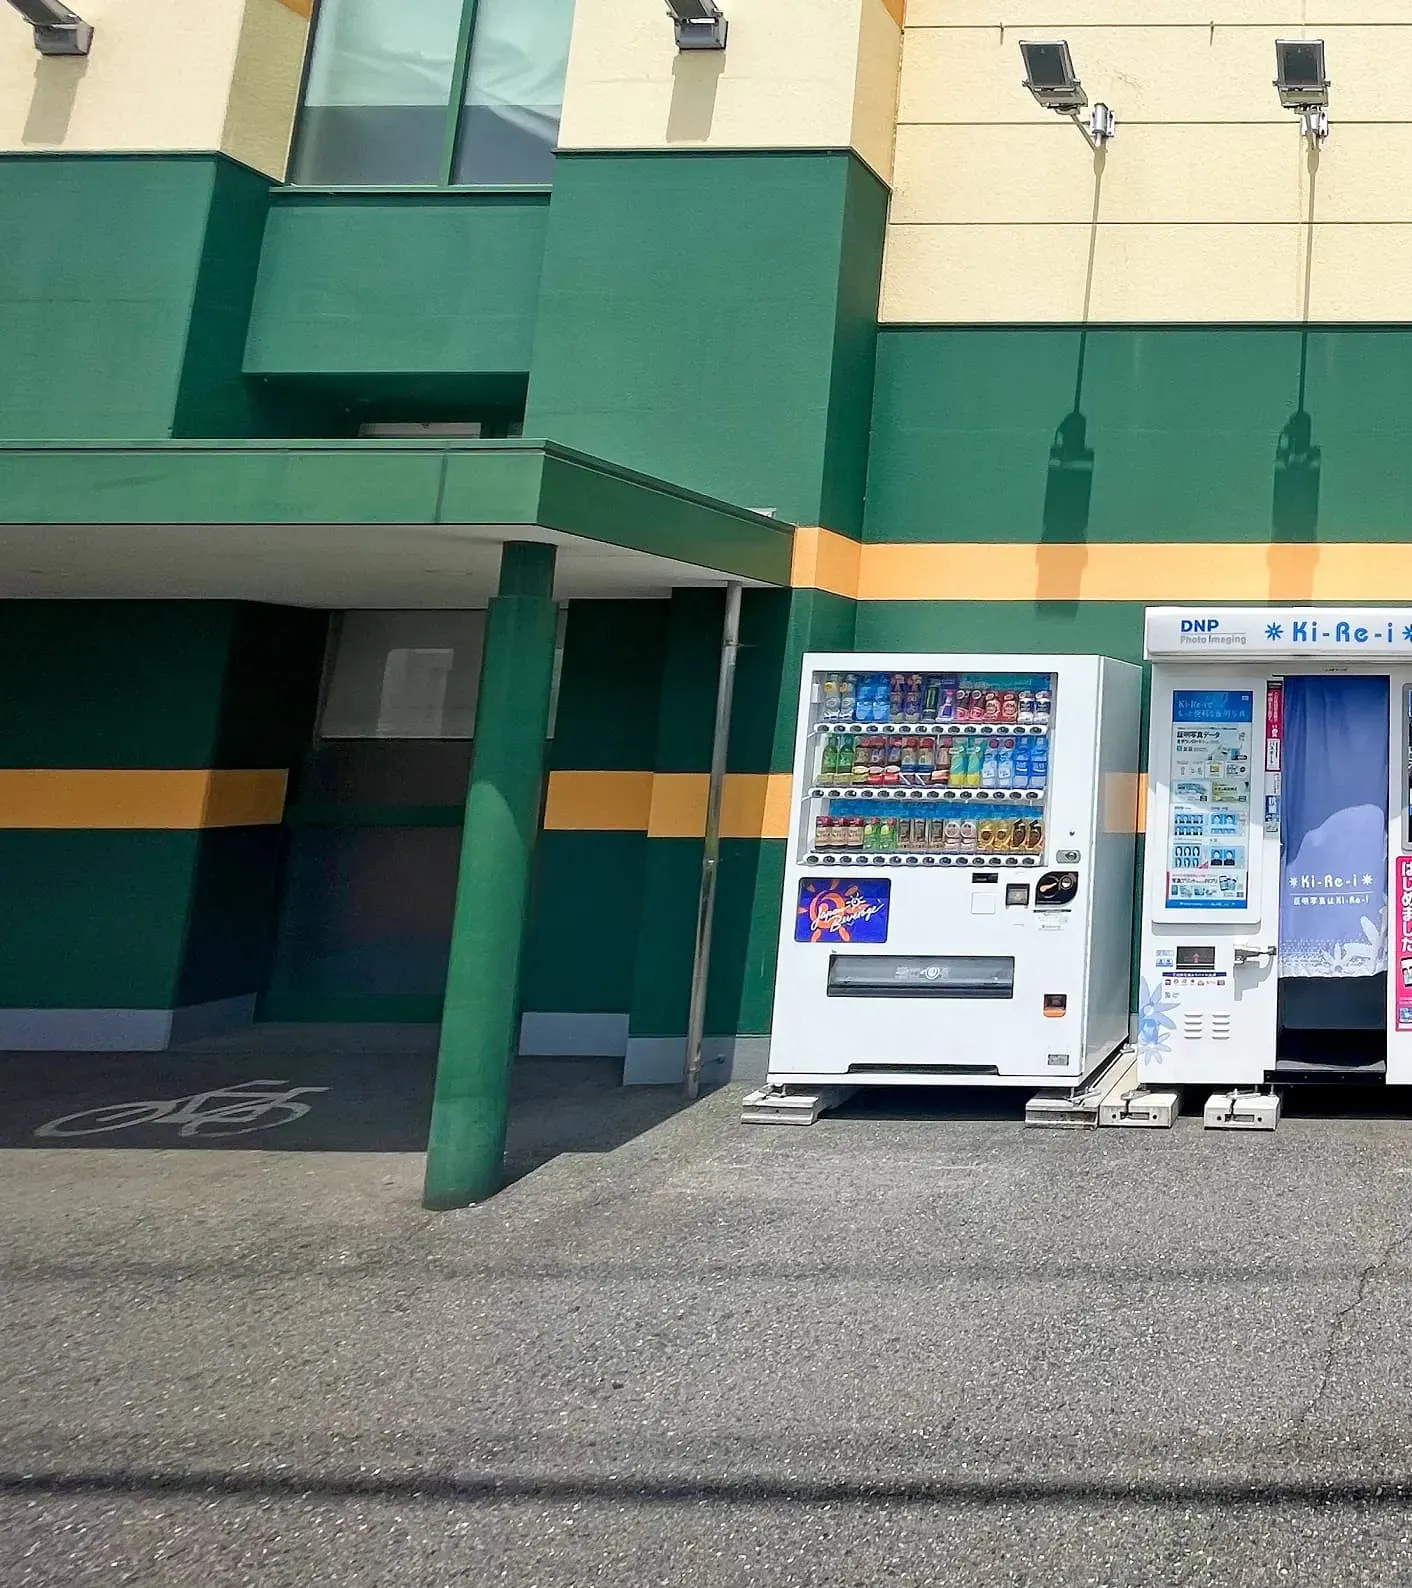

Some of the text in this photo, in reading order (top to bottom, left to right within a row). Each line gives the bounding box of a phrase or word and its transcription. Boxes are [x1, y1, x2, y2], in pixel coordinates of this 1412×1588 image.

[1180, 619, 1220, 633] DNP
[1292, 621, 1393, 643] Ki-Re-i
[1180, 634, 1247, 646] Photo Imaging
[1301, 873, 1358, 888] Ki-Re-i
